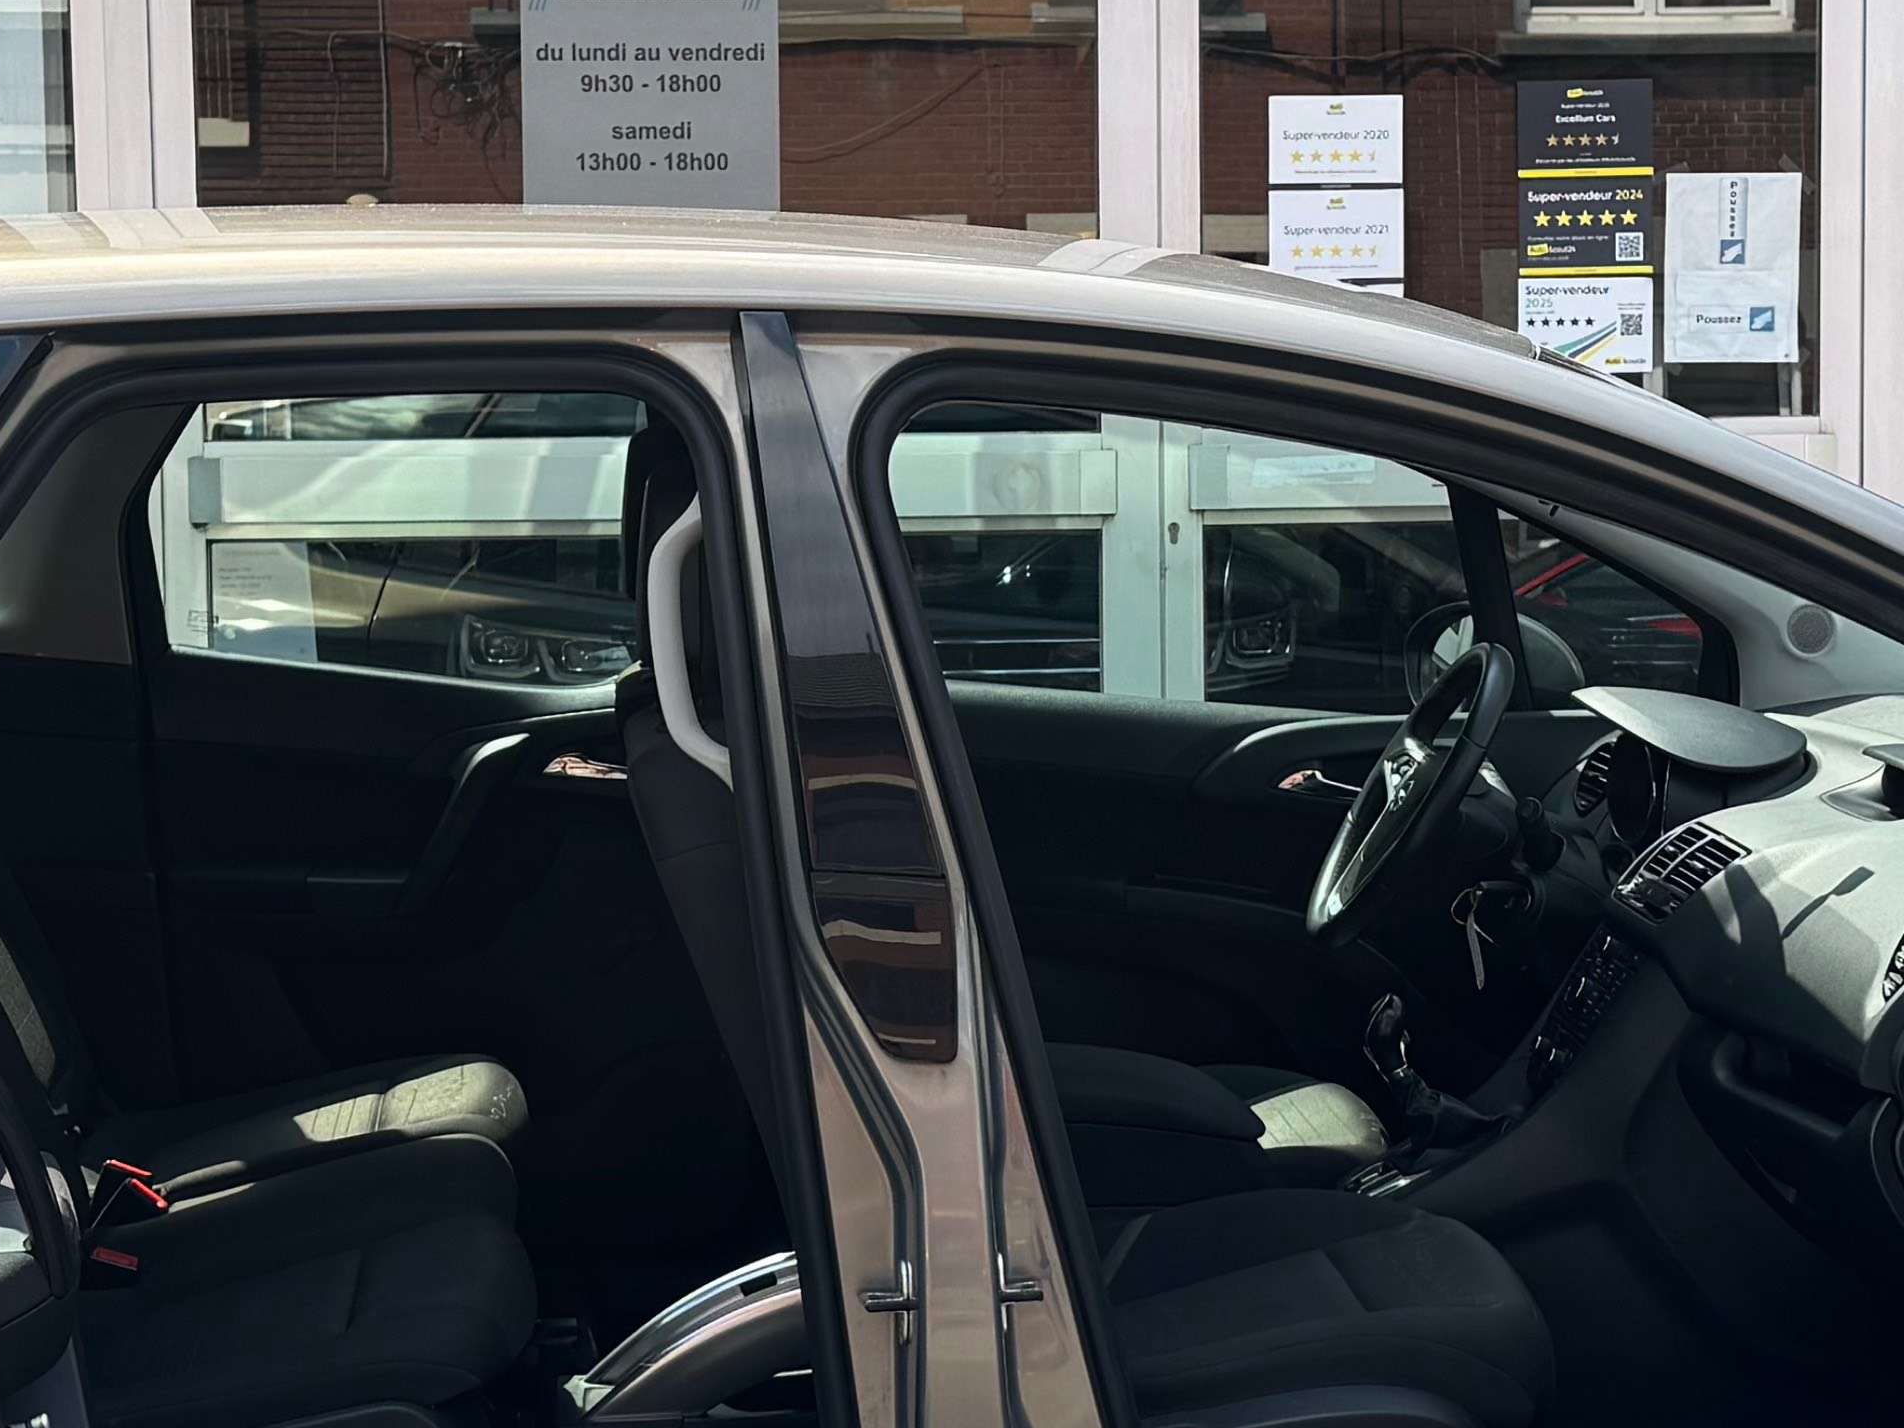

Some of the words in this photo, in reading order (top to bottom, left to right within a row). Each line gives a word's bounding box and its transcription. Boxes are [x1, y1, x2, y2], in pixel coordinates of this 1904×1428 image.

[536, 44, 563, 62] du
[572, 43, 626, 62] lundi
[634, 49, 660, 62] au
[668, 43, 765, 62] vendredi
[581, 75, 633, 93] 9h30
[656, 75, 721, 93] 18h00
[611, 121, 692, 140] samedi
[1283, 130, 1360, 141] Super-vendeur
[1363, 129, 1389, 140] 2020
[576, 153, 641, 171] 13h00
[664, 153, 729, 171] 18h00
[1527, 190, 1612, 204] Super-vendeur
[1616, 189, 1643, 201] 2024
[1284, 225, 1361, 237] Super-vendeur
[1365, 224, 1389, 235] 2021
[1525, 285, 1610, 297] Super-vendeur
[1525, 297, 1553, 309] 2025
[1696, 313, 1742, 324] Poussez
